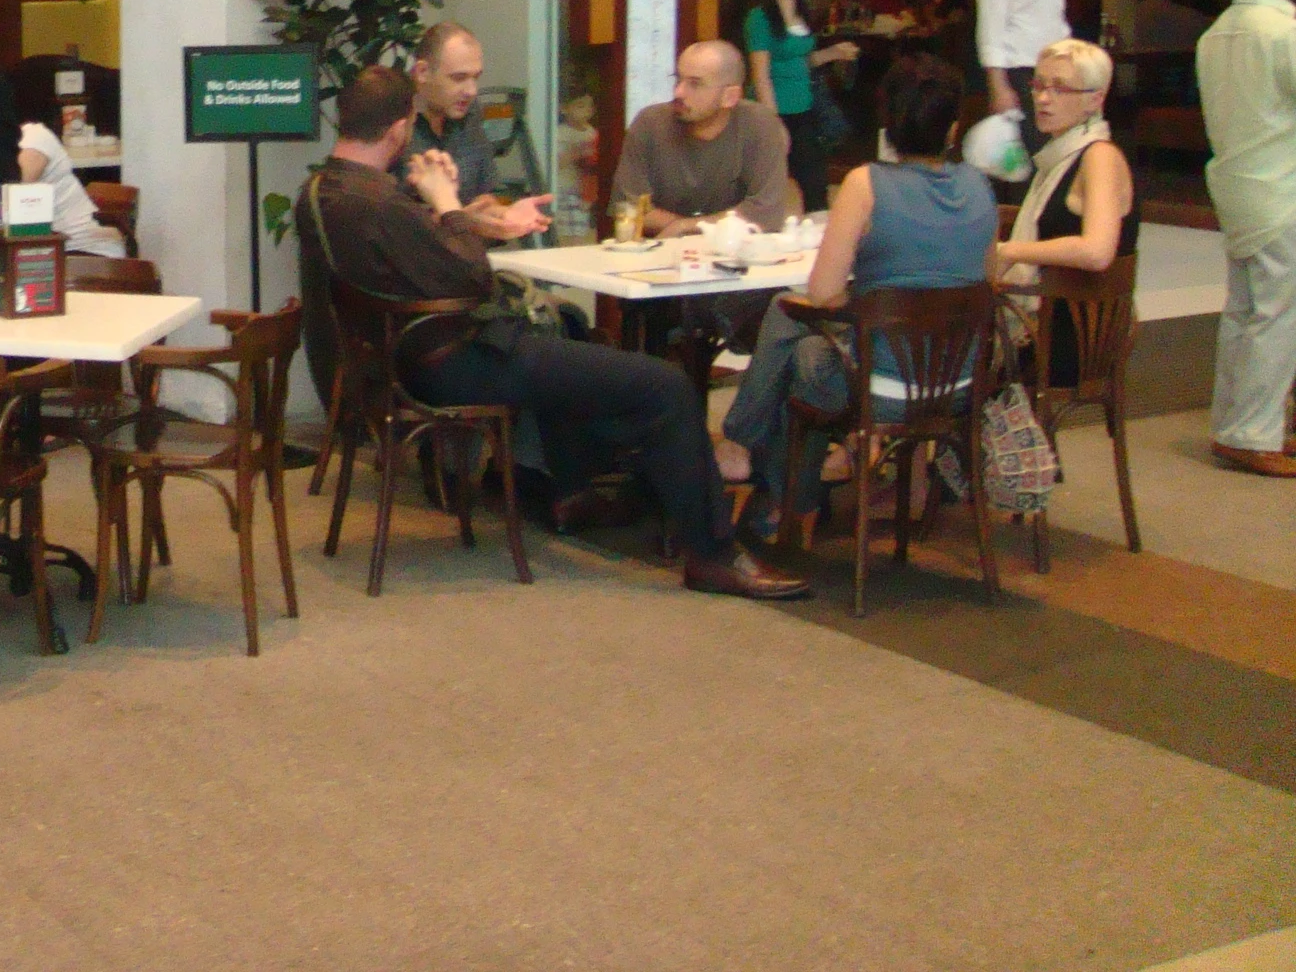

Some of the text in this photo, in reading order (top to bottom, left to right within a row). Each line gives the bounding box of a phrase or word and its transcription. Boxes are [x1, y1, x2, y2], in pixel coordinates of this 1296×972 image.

[207, 78, 301, 91] No Outside Food
[204, 92, 302, 105] & Drinks Allowed
